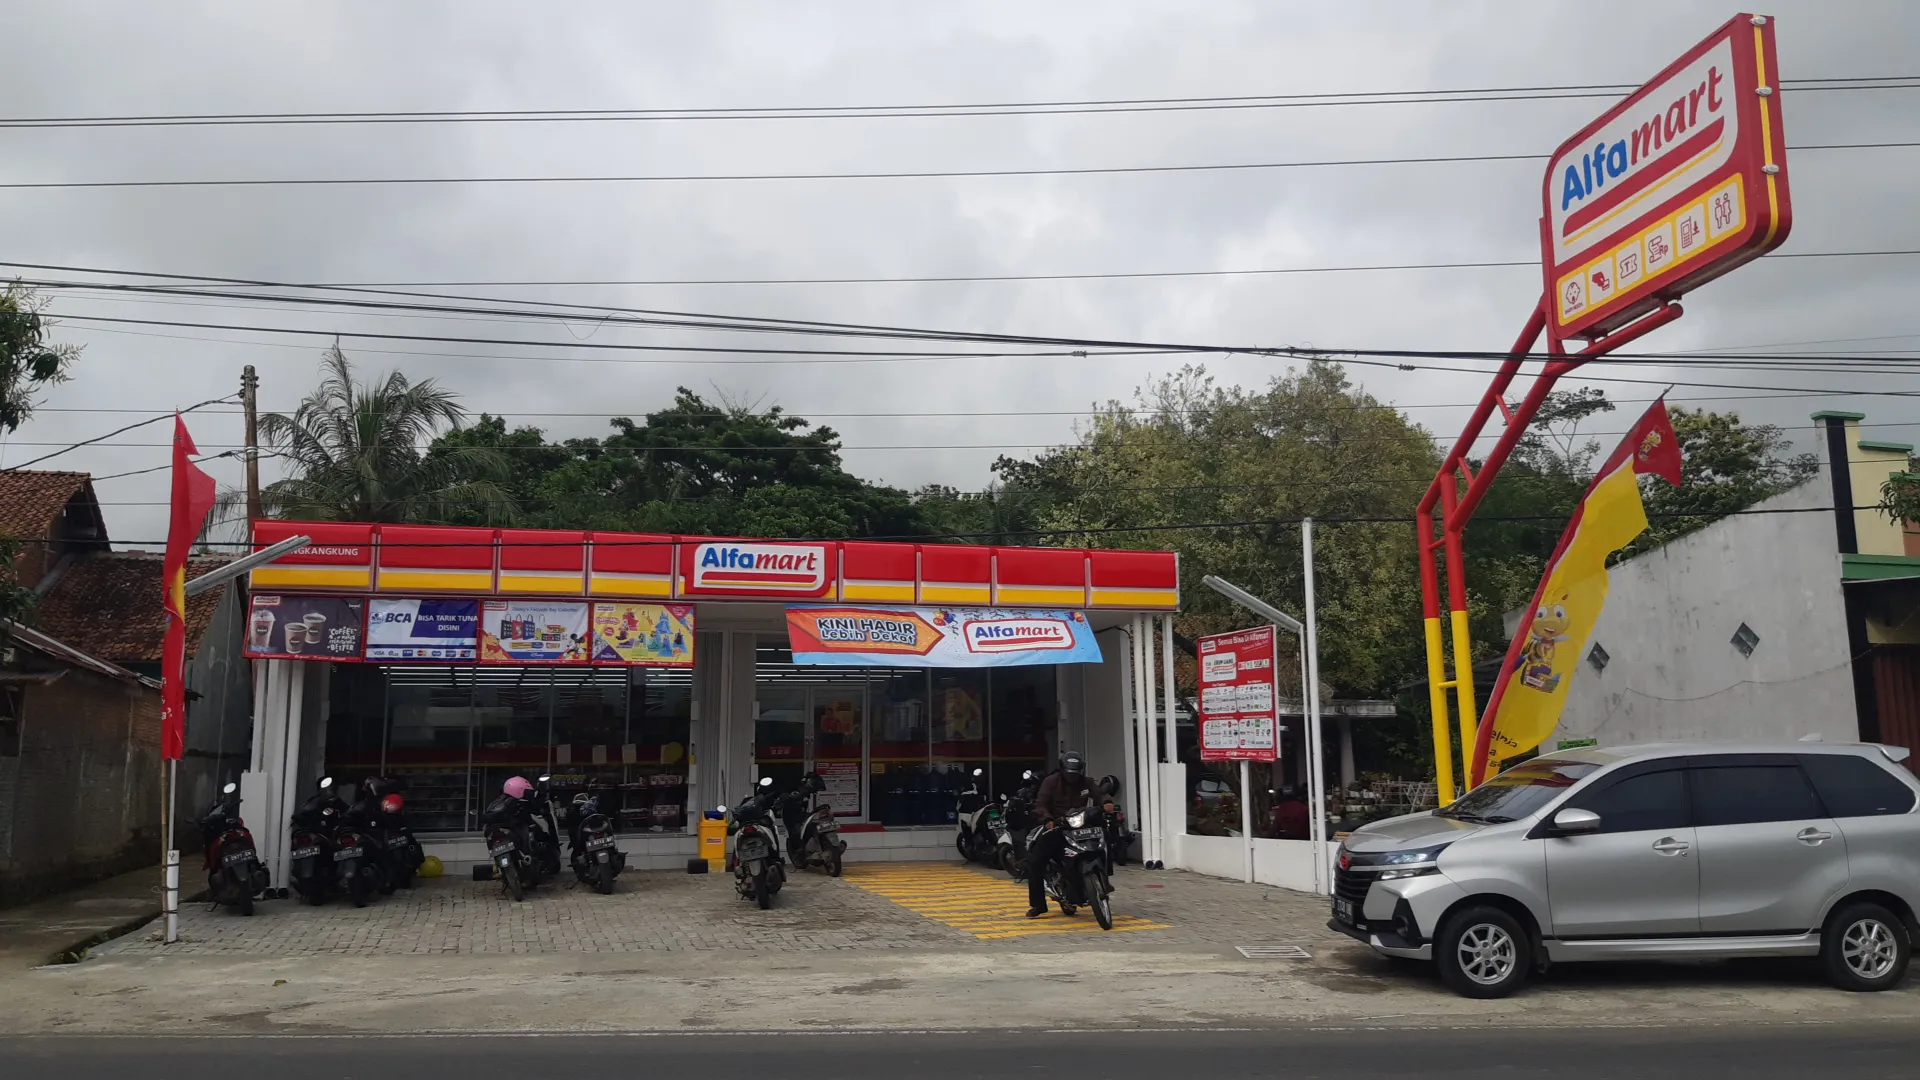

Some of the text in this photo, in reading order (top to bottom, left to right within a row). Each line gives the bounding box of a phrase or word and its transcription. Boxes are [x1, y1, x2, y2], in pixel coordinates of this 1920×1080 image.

[1562, 65, 1723, 211] Alfamart
[701, 547, 817, 571] Alfamart
[385, 613, 412, 623] BCA
[817, 618, 914, 634] KINI HADIR
[975, 626, 1060, 638] Alfamart
[822, 630, 914, 643] Lebih Dekat
